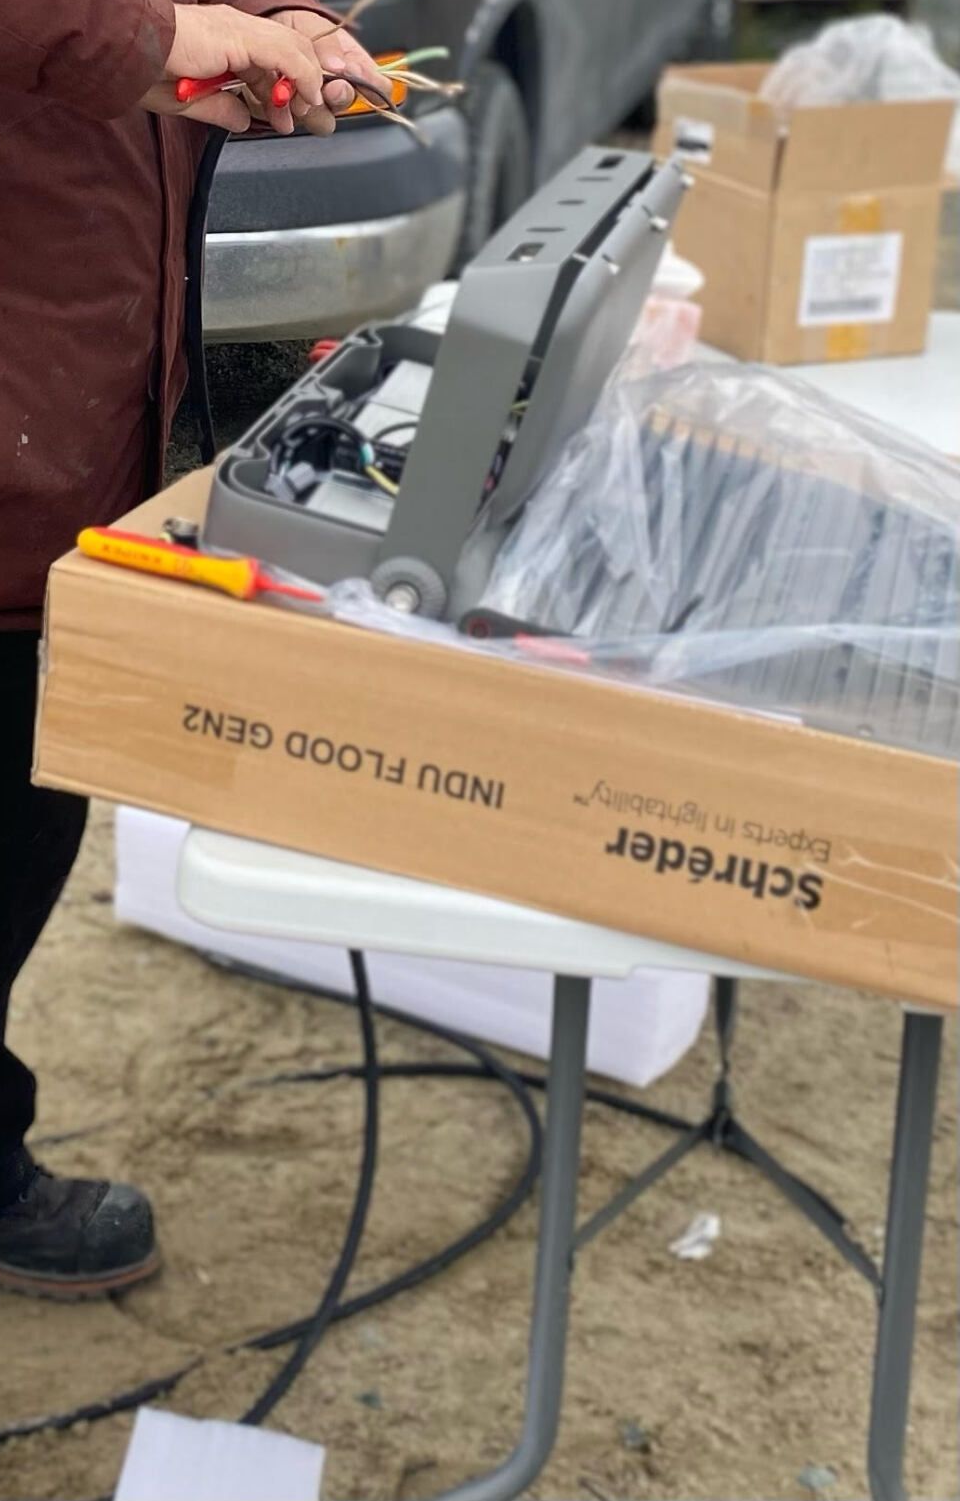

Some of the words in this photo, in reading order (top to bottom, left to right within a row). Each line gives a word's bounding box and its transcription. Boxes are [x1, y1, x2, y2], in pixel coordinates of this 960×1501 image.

[182, 703, 274, 750] GEN2
[285, 731, 407, 785] FLOOD
[417, 763, 505, 810] INDU
[714, 813, 736, 839] in
[742, 820, 832, 863] Experts
[604, 827, 824, 911] Schréder
